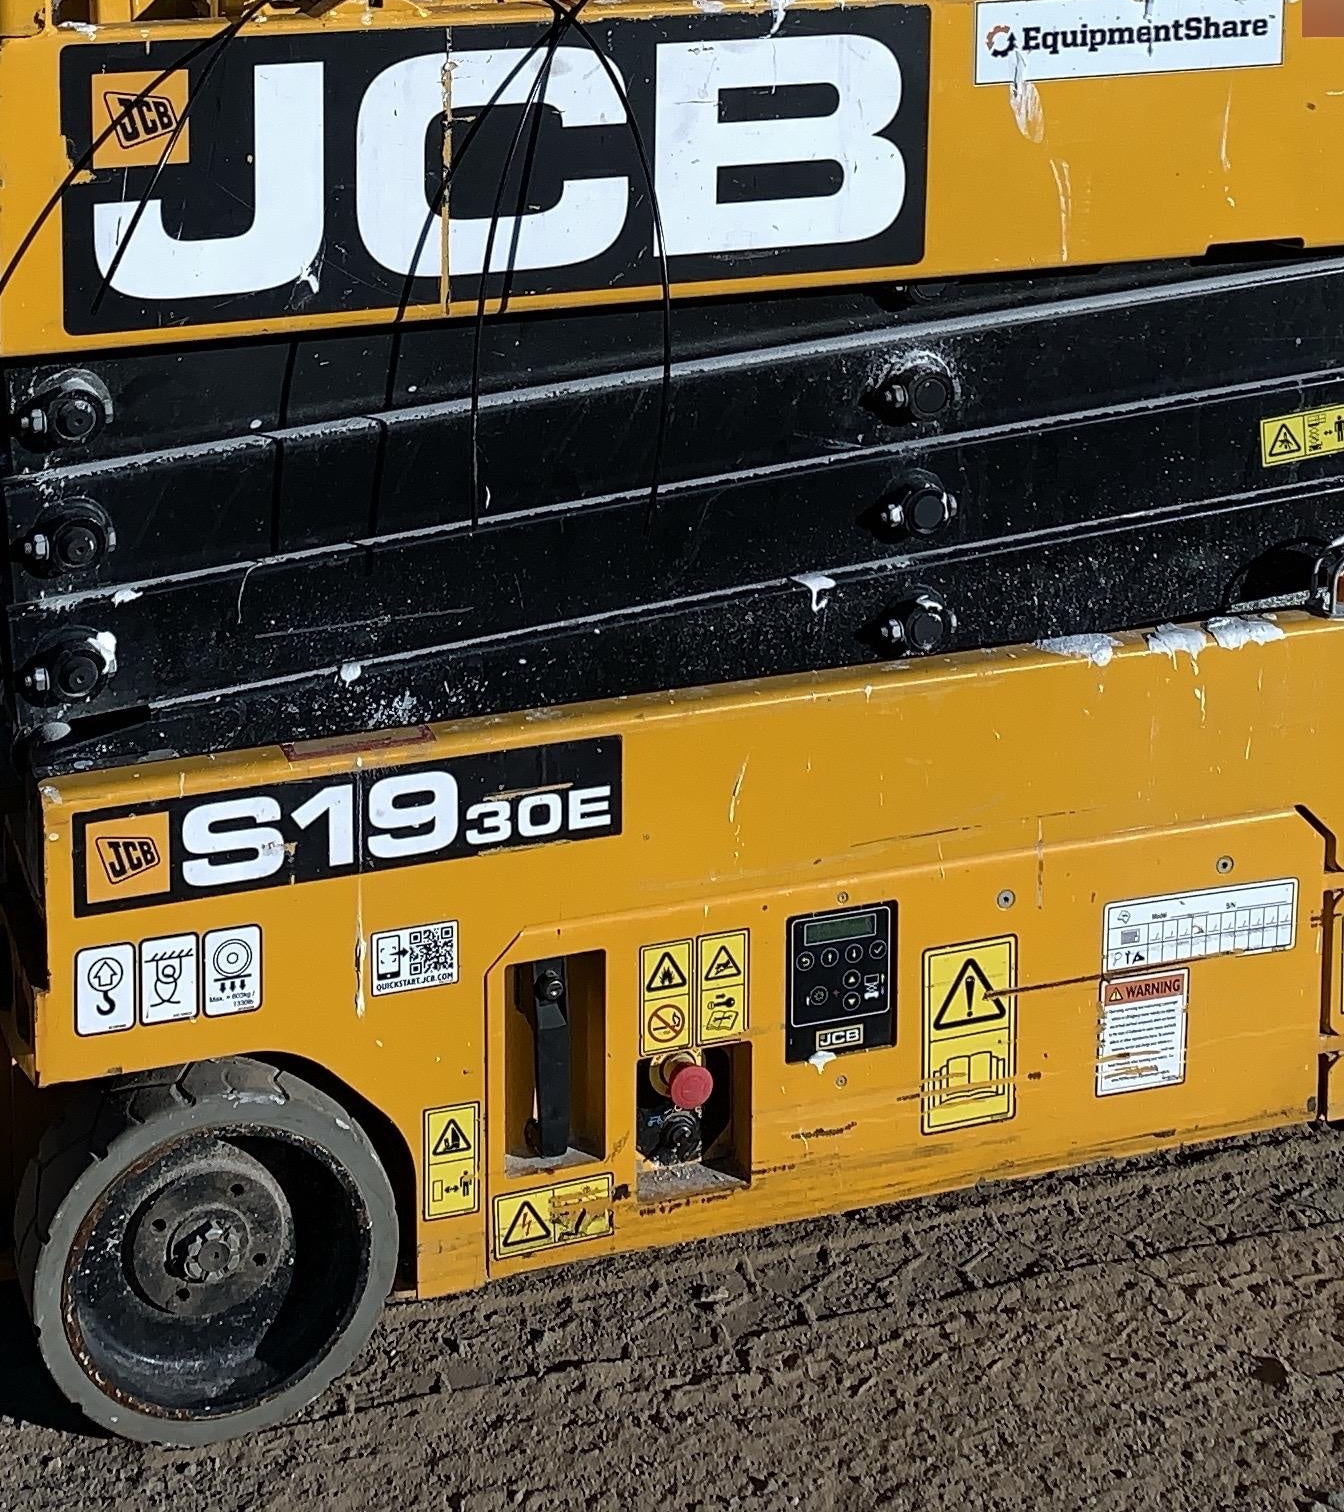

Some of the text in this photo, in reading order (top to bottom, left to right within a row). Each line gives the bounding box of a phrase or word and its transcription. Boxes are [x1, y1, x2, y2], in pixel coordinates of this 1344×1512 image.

[1021, 14, 1270, 55] EquipmentShare
[115, 95, 178, 141] JCB
[93, 32, 907, 300] JCB
[106, 836, 157, 872] JCB
[376, 972, 454, 993] QUICKSTART.JCB.COM
[1125, 978, 1181, 1000] WARNING
[818, 1025, 861, 1049] JCB
